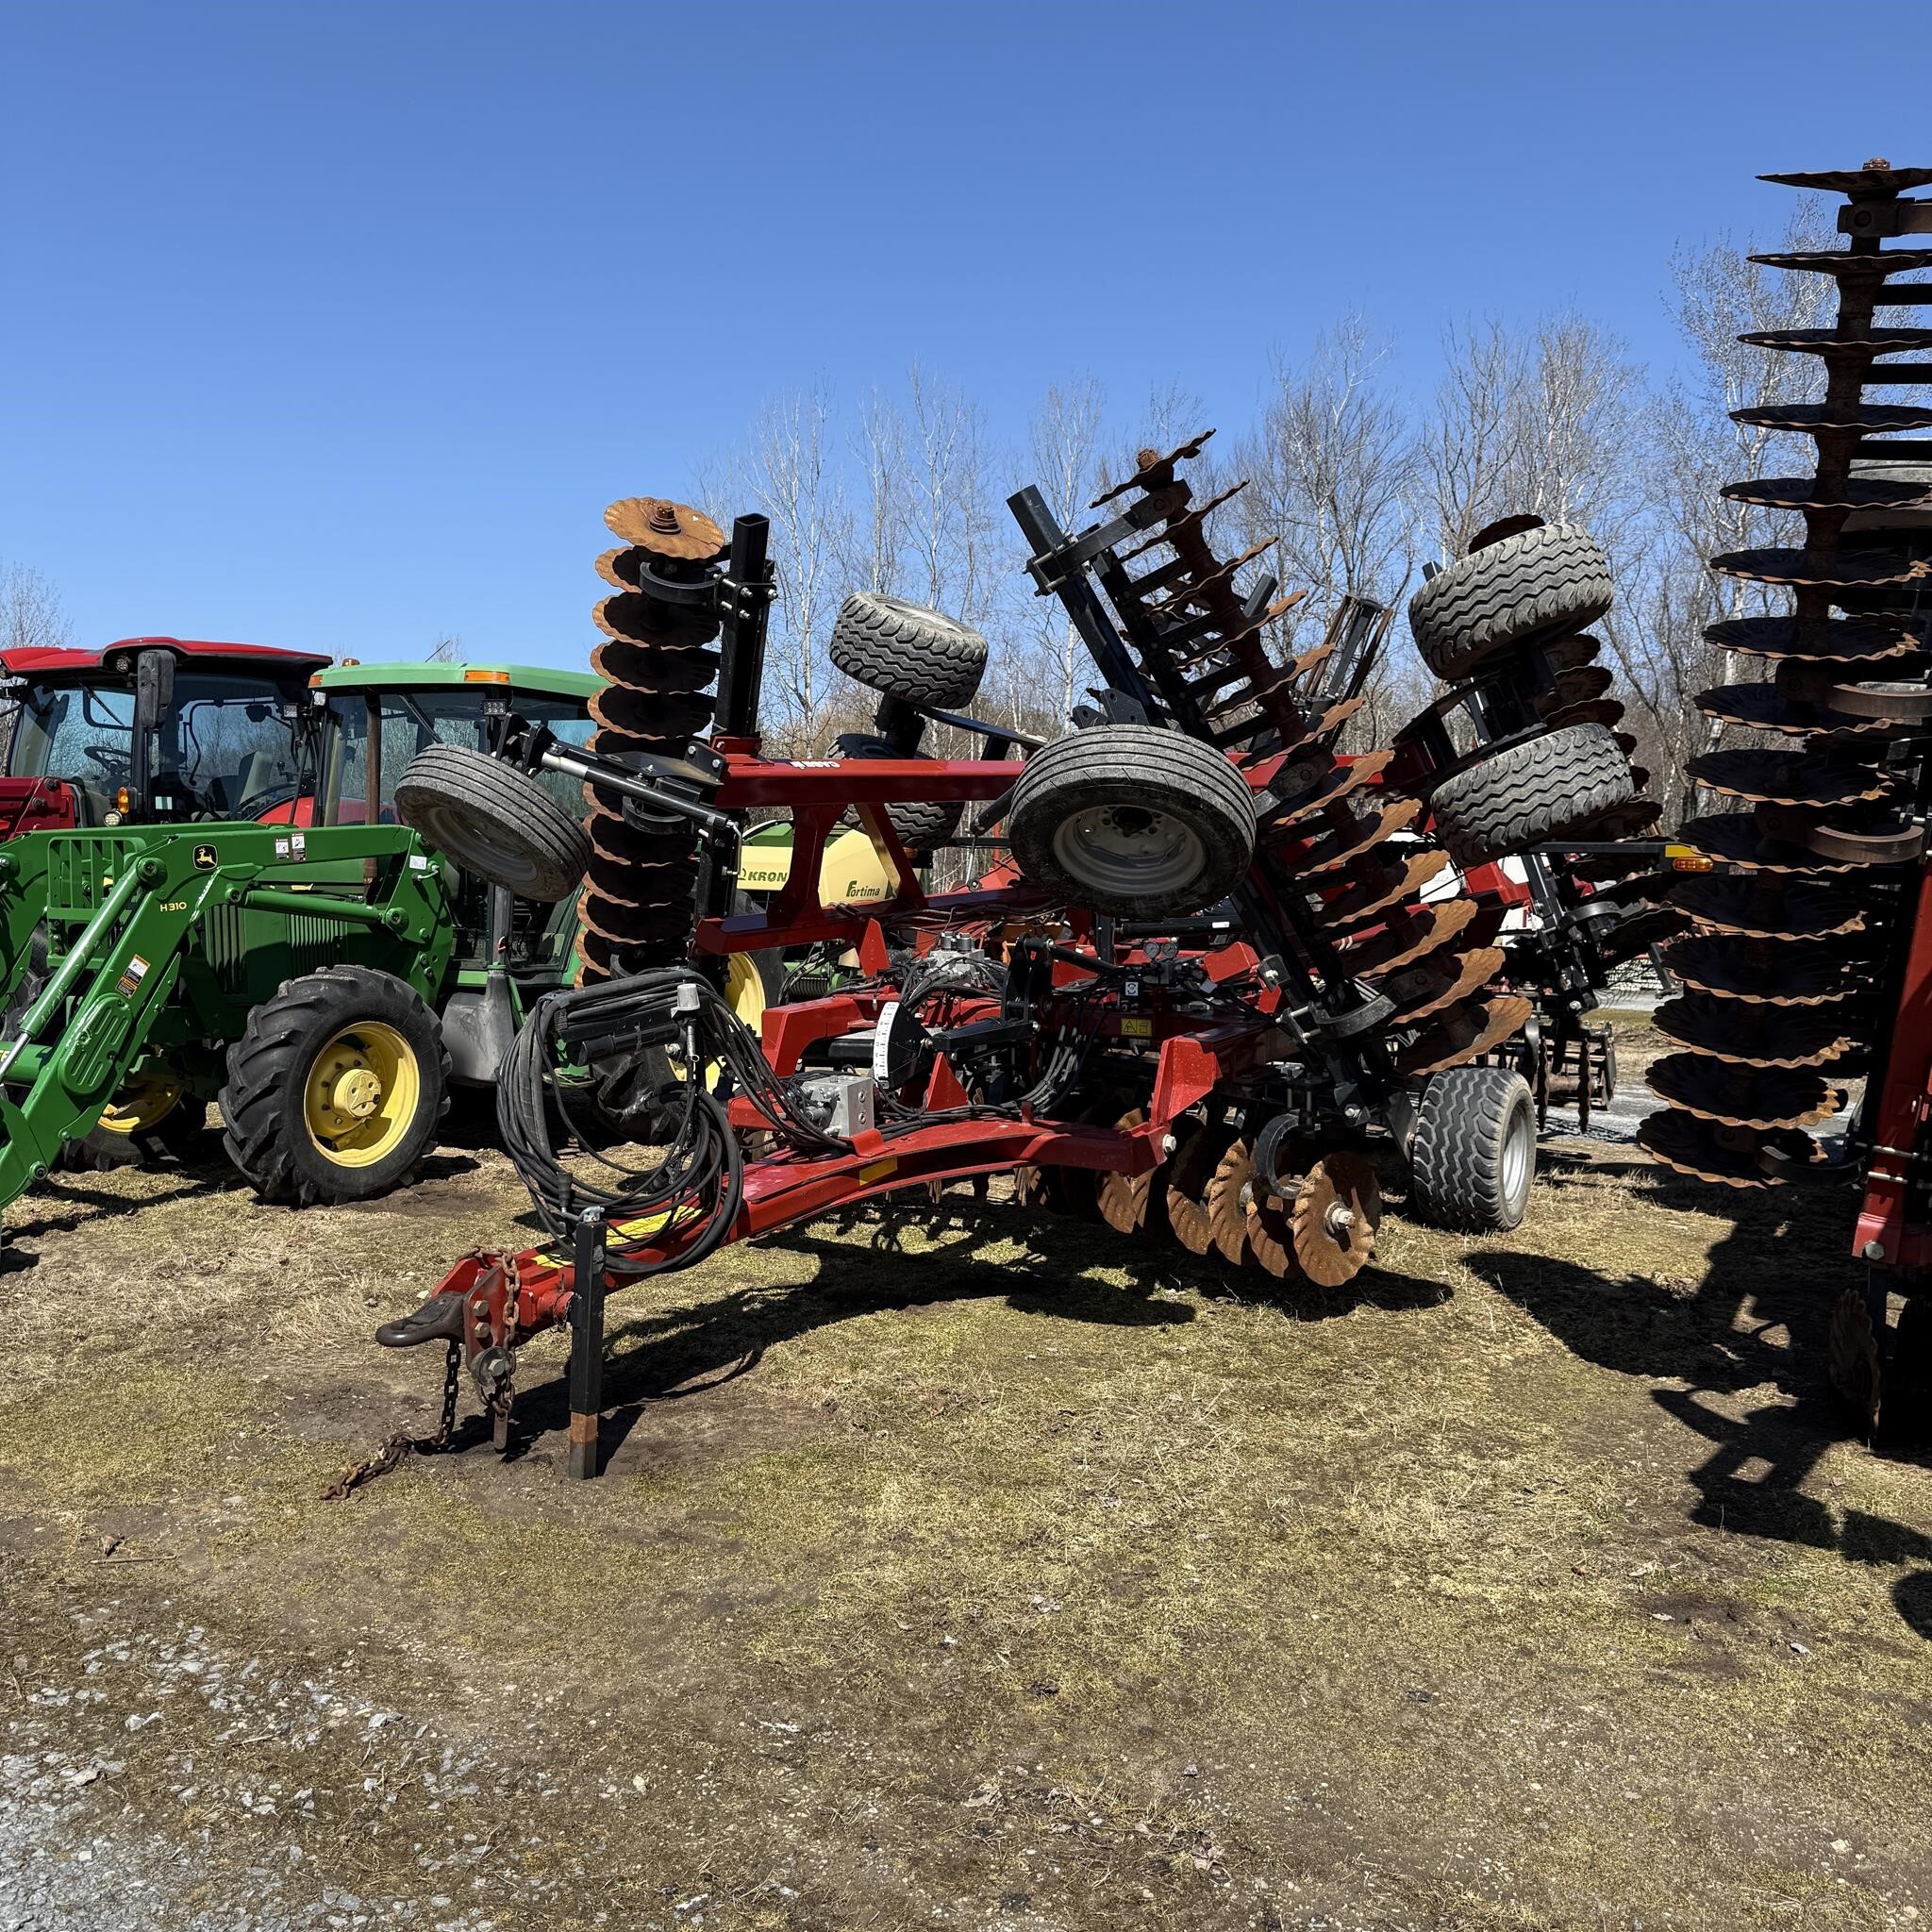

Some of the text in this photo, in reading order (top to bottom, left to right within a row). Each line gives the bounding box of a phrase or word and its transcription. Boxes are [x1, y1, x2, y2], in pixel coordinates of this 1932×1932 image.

[747, 871, 788, 882] KRON
[846, 880, 880, 897] Fortima
[160, 902, 187, 911] H310
